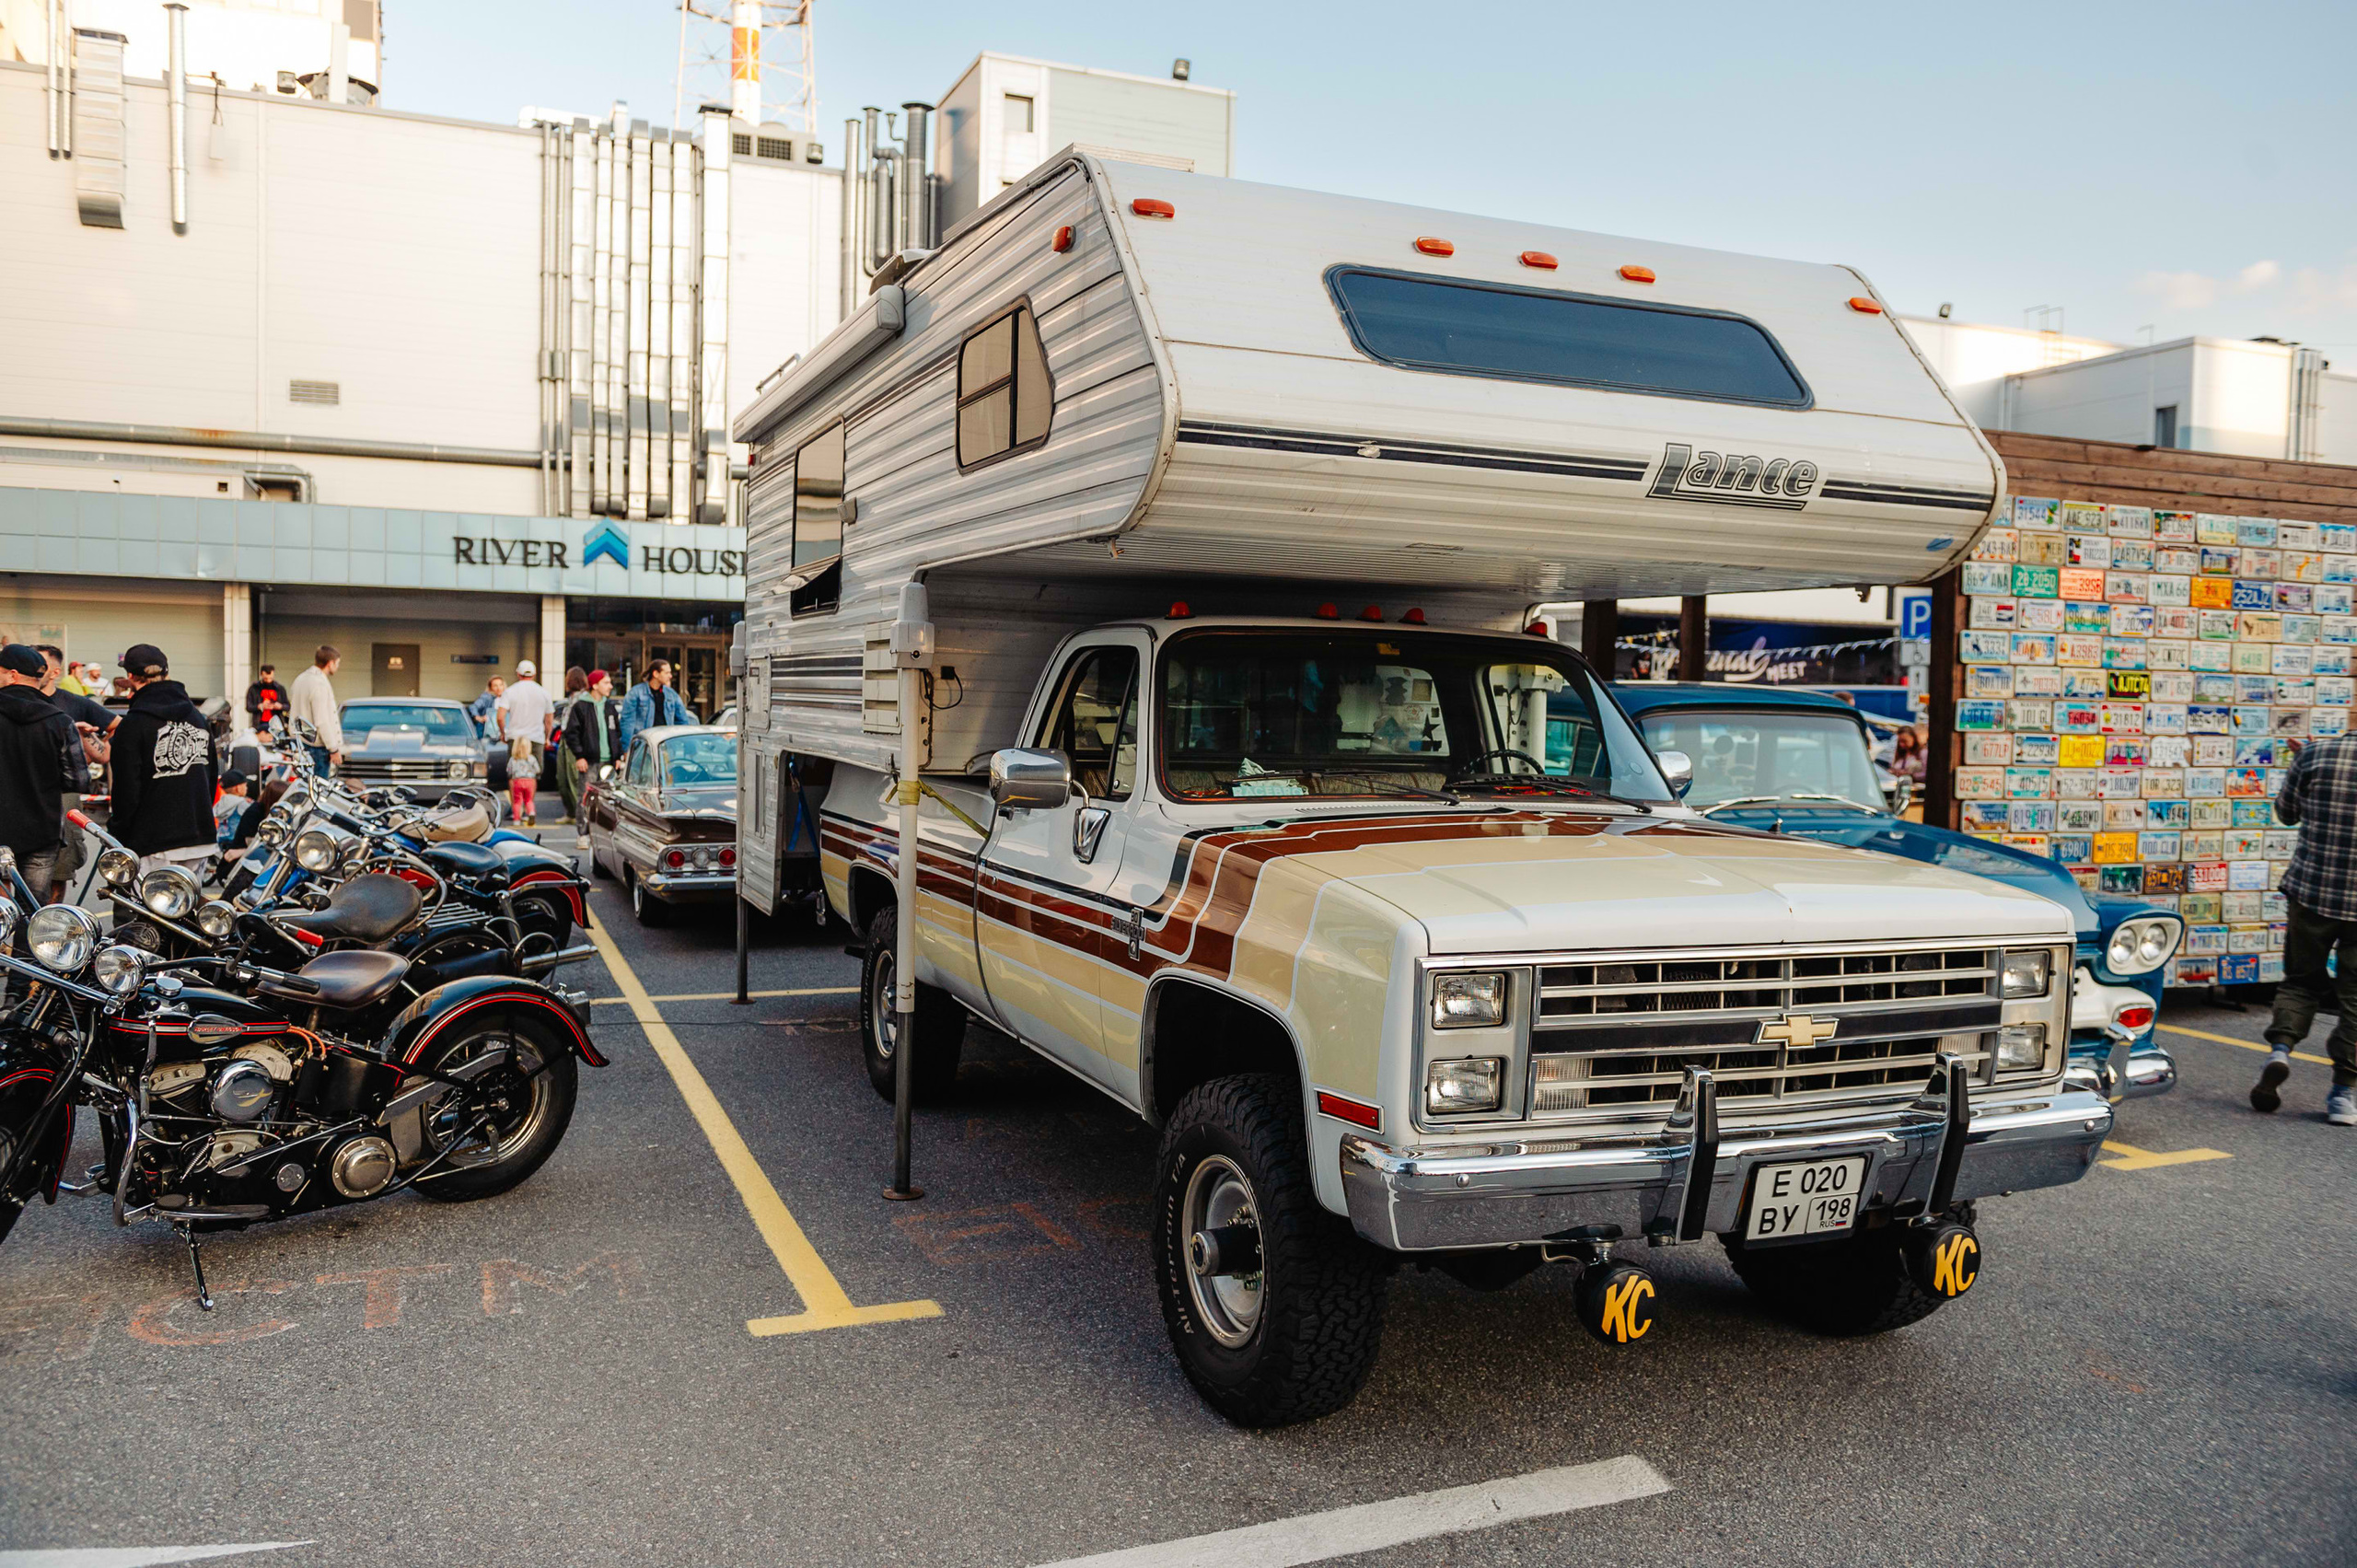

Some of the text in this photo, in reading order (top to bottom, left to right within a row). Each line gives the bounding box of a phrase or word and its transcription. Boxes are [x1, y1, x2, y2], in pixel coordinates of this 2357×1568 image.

[1645, 442, 1818, 510] Lance
[452, 536, 747, 577] RIVER HOUS
[1910, 600, 1931, 636] P
[1767, 661, 1806, 684] MEET
[1110, 916, 1145, 942] SILVERADO
[1771, 1164, 1848, 1198] E 020
[1758, 1197, 1852, 1236] BY 198
[1818, 1220, 1836, 1229] RUS
[1166, 1152, 1196, 1335] All-Terrain T/A
[1933, 1234, 1978, 1296] KC
[1601, 1274, 1655, 1343] KC
